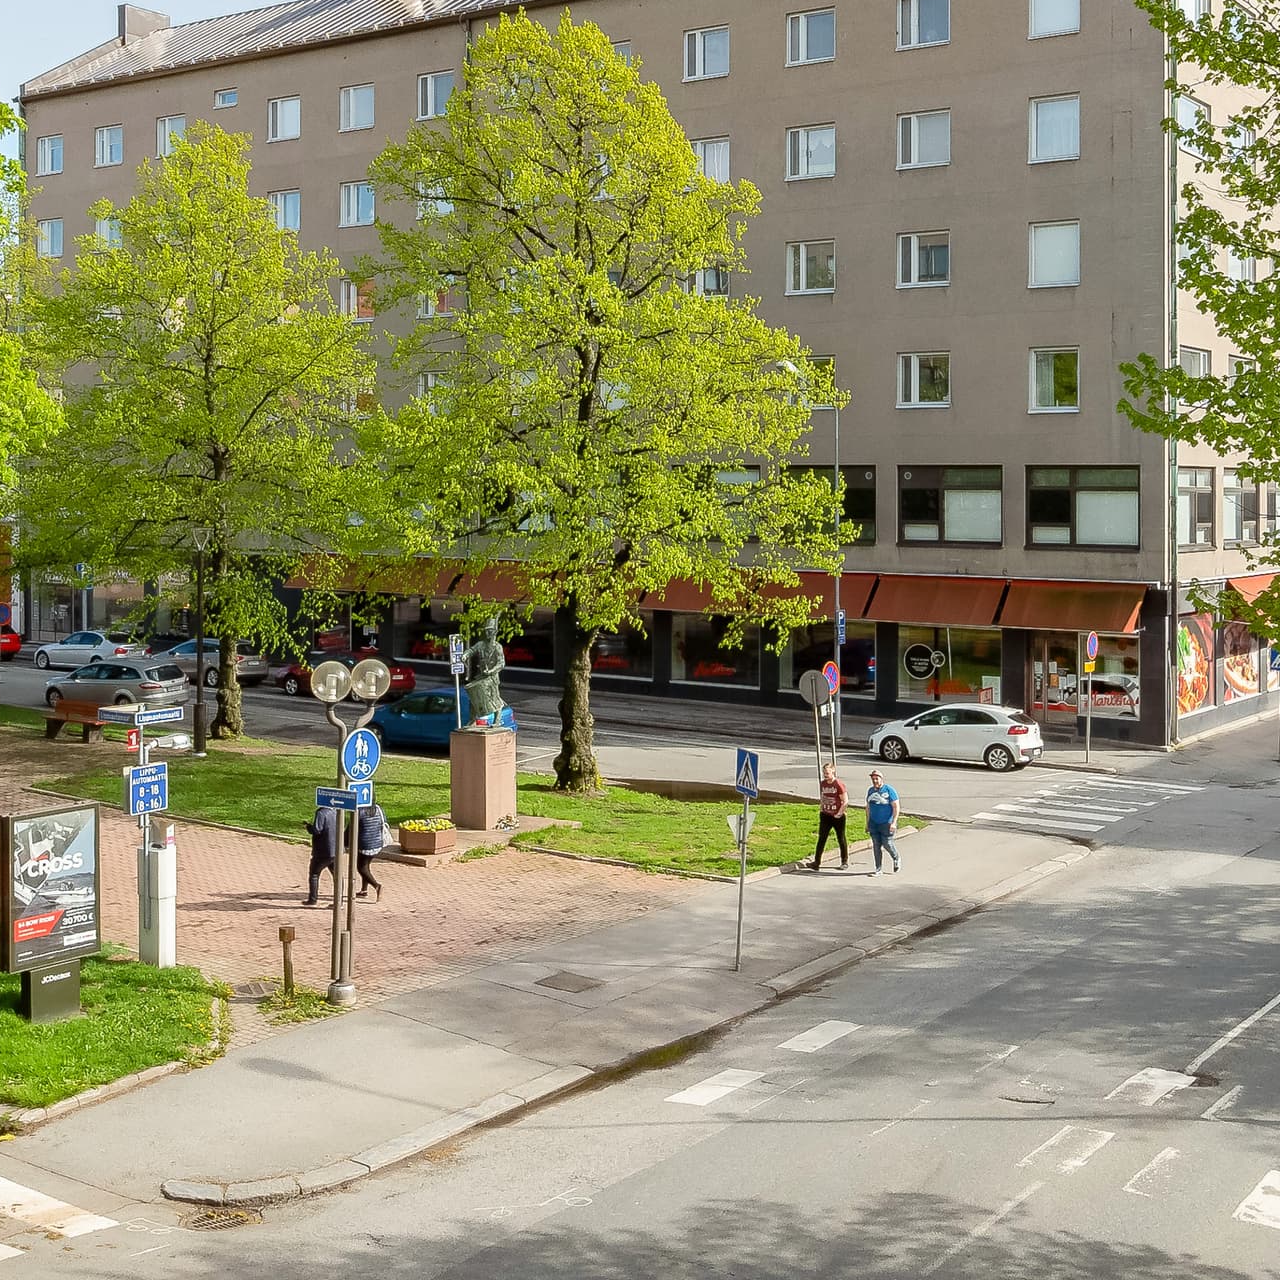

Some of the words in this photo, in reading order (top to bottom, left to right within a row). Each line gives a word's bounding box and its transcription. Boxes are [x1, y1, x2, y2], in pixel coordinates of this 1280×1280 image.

[129, 732, 136, 746] 1
[132, 773, 166, 785] AUTOMAATTI
[139, 768, 158, 777] LIPPU-
[27, 852, 82, 877] CROSS
